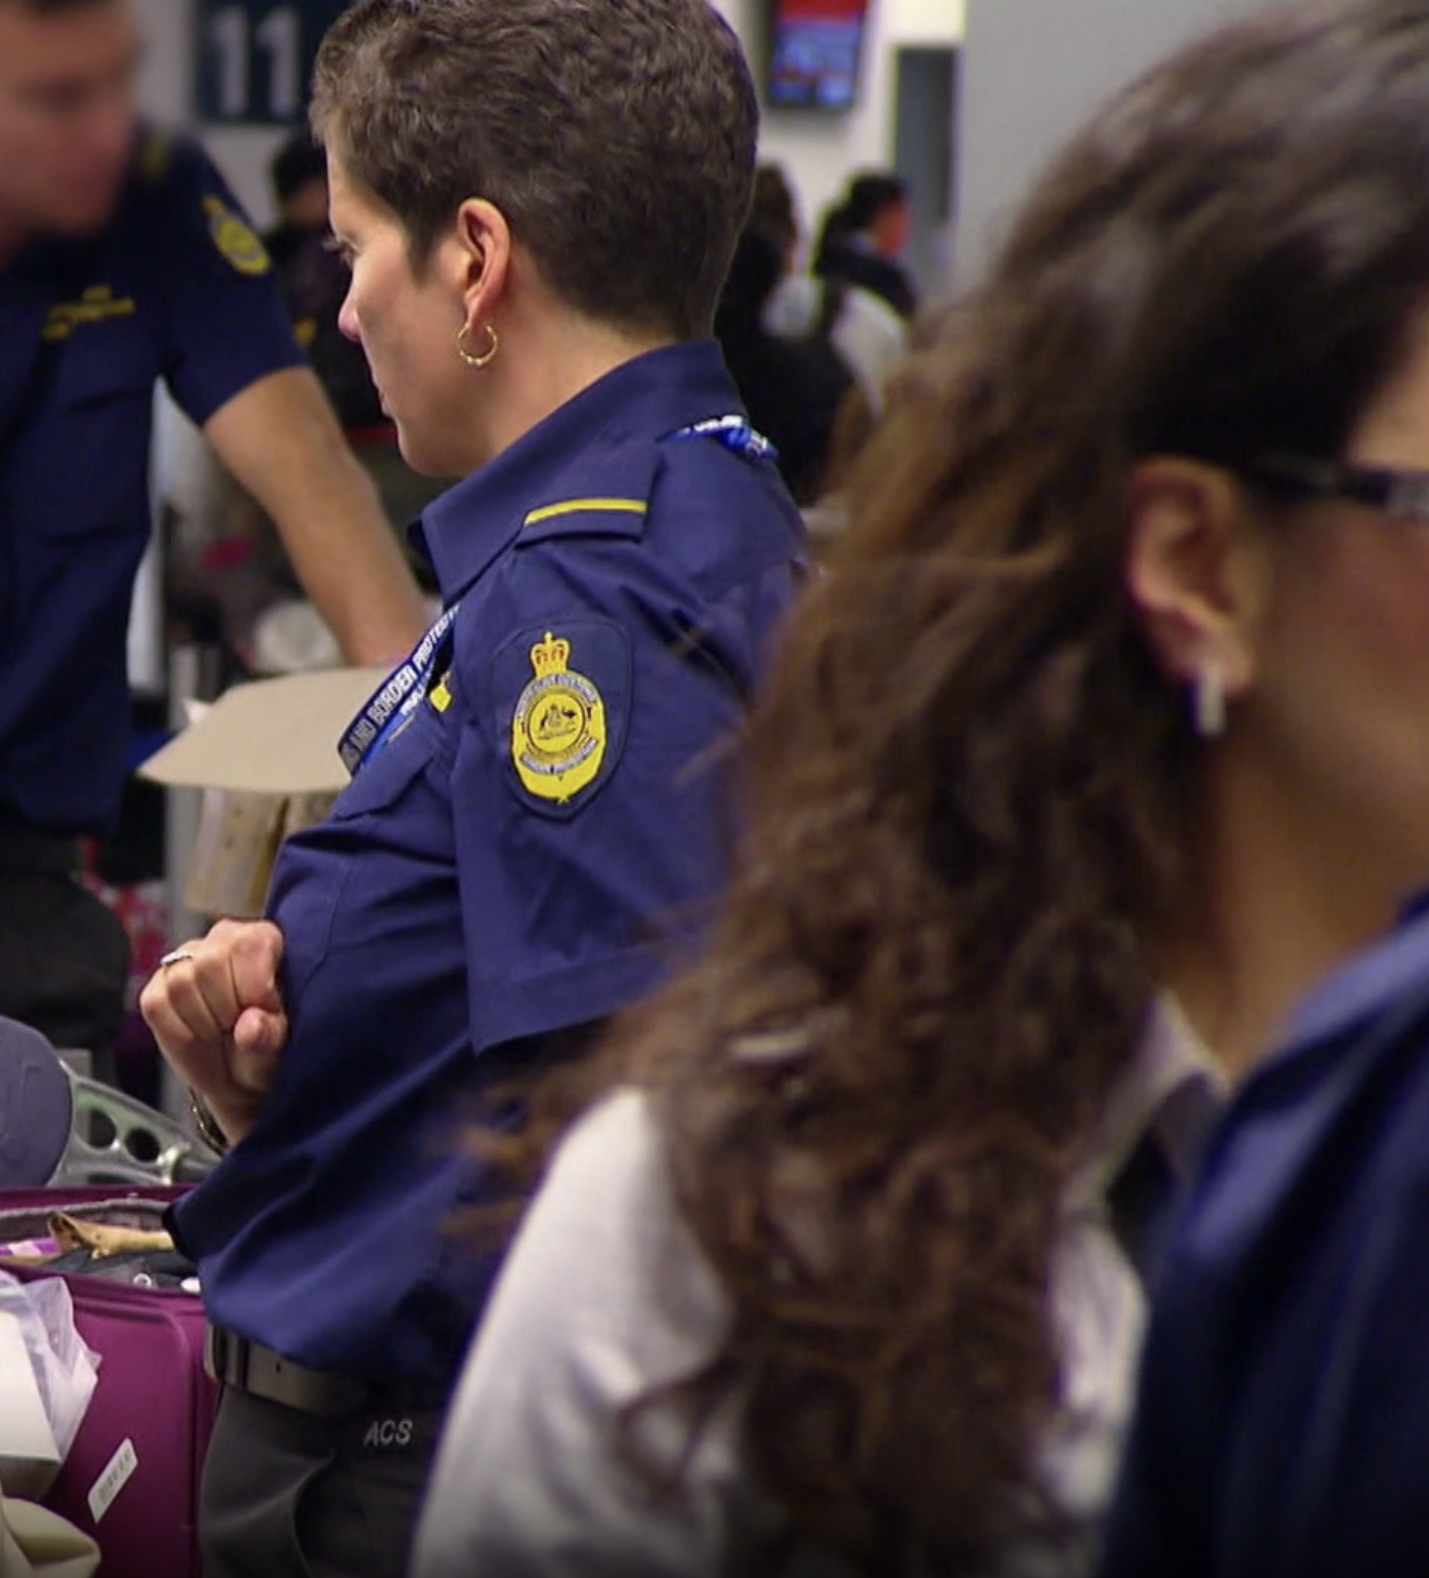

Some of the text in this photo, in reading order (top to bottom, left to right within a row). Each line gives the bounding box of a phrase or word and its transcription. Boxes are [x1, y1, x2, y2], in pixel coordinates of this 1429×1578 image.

[212, 9, 298, 117] 11
[367, 664, 418, 727] BORDER
[362, 1419, 413, 1447] ACS
